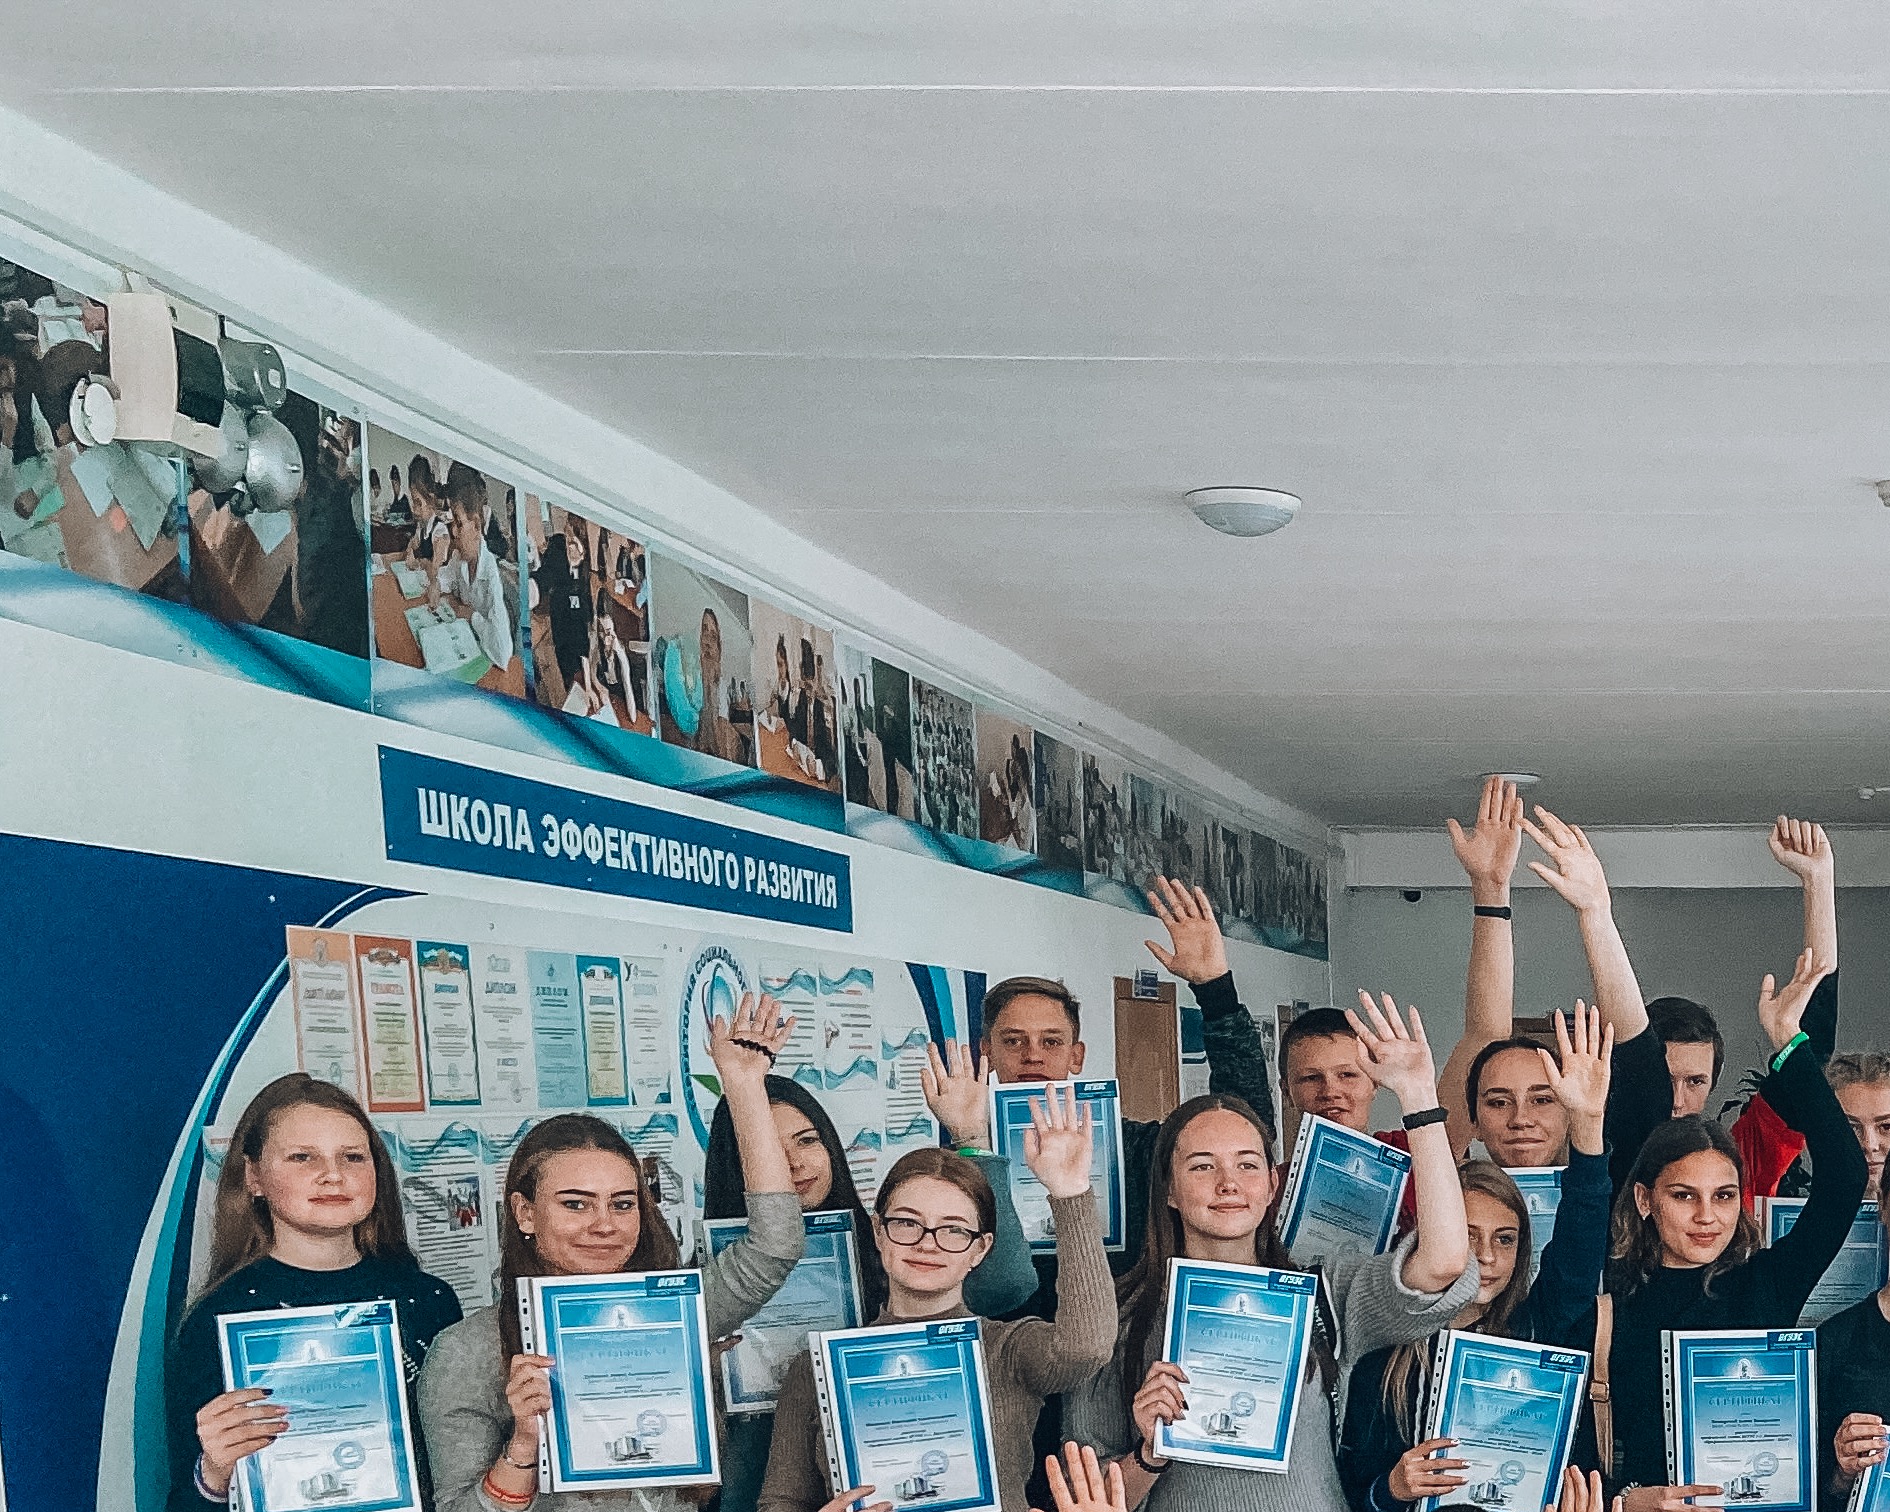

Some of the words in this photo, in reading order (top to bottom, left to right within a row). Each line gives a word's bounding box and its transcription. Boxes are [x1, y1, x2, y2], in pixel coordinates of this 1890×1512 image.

[417, 787, 535, 855] ШКОЛА
[541, 814, 740, 890] ЭФФЕКТИВНОГО
[744, 856, 838, 909] РАЗВИТИЯ
